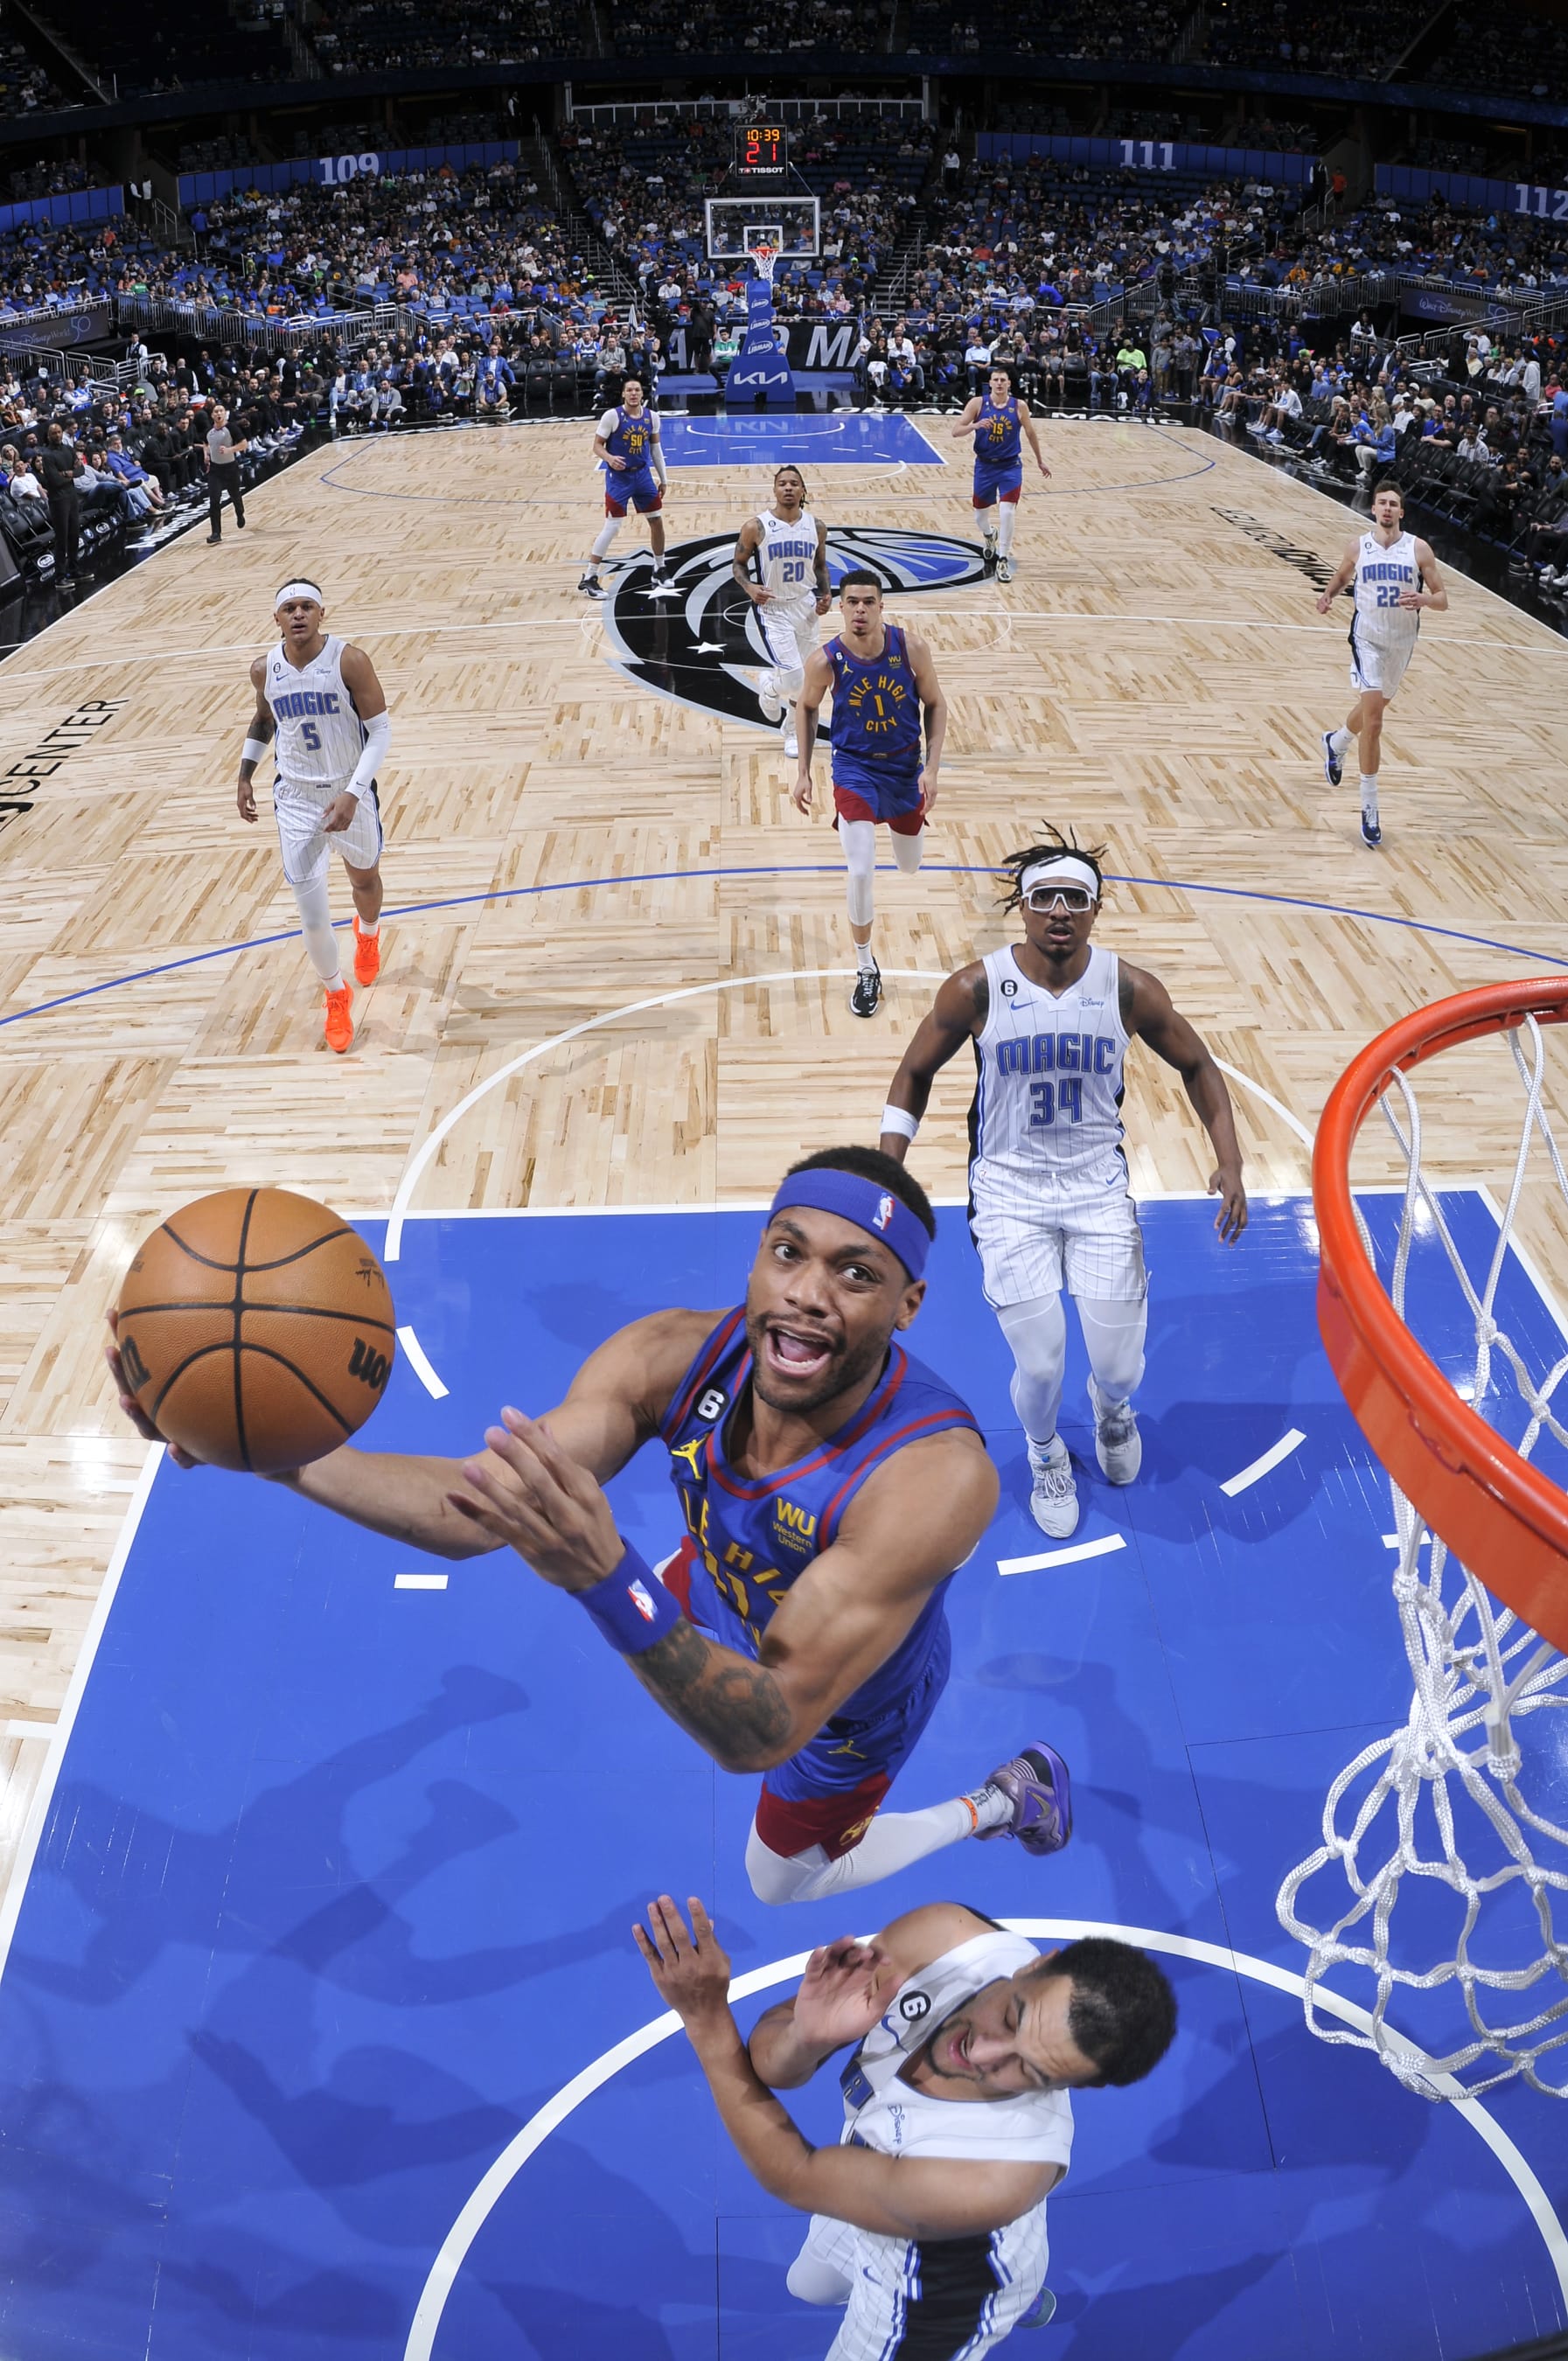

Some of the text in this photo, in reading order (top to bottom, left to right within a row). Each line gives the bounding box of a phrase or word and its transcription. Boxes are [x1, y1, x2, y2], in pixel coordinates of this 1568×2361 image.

[747, 129, 780, 142] 10:39
[746, 142, 777, 164] 21
[1120, 139, 1176, 171] 111
[319, 152, 379, 185] 109
[1515, 184, 1568, 221] 112
[71, 316, 91, 343] 50
[993, 422, 1004, 435] 15
[1051, 412, 1184, 426] MAGIC
[631, 434, 643, 447] 50
[768, 540, 816, 561] MAGIC
[783, 561, 805, 582] 20
[1362, 562, 1413, 584] MAGIC
[1376, 585, 1401, 608] 22
[847, 677, 873, 707] MILE
[273, 691, 341, 723] MAGIC
[874, 694, 885, 716] 1
[300, 721, 322, 751] 5
[866, 716, 898, 733] CITY
[0, 699, 130, 797] CENTER
[1004, 981, 1015, 994] 6
[1078, 996, 1105, 1009] Disney
[995, 1032, 1116, 1076] MAGIC
[1029, 1077, 1083, 1126] 34
[697, 1388, 725, 1420] 6
[777, 1496, 817, 1536] WU
[772, 1520, 813, 1549] Western
[777, 1533, 807, 1555] Union
[903, 1995, 927, 2016] 6
[887, 2102, 906, 2144] Disney
